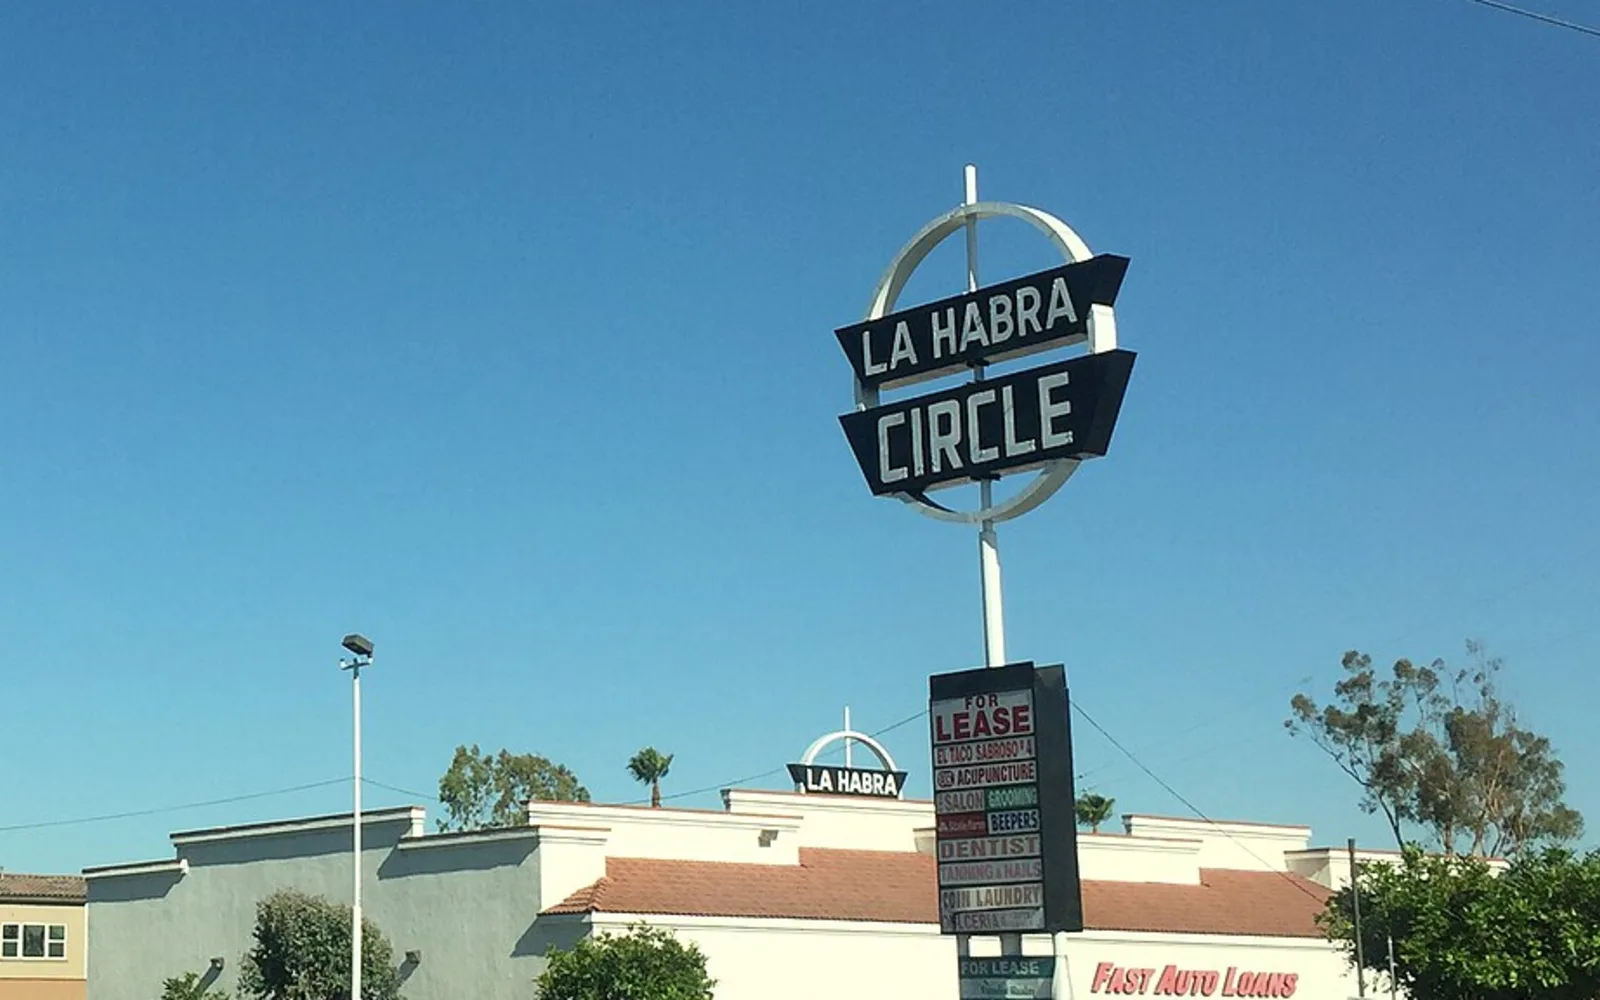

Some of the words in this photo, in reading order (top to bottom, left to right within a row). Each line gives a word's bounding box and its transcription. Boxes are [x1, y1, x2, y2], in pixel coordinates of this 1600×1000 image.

[862, 320, 919, 377] LA
[931, 277, 1078, 359] HABRA
[877, 371, 1074, 484] CIRCLE
[965, 694, 998, 710] FOR
[936, 705, 1031, 741] LEASE
[937, 748, 948, 764] EL
[950, 745, 973, 763] TACO
[806, 768, 833, 792] LA
[838, 770, 897, 796] HABRA
[957, 763, 1035, 786] ACUPUNCTURE
[945, 790, 984, 811] SALON
[988, 786, 1038, 808] GROOMING
[991, 811, 1038, 831] BEEPERS
[941, 836, 1039, 858] DENTIST
[1004, 861, 1042, 878] NAILS
[943, 890, 971, 909] COIN
[976, 885, 1041, 907] LAUNDRY
[961, 961, 988, 975] FOR
[992, 961, 1040, 975] LEASE
[1091, 962, 1155, 995] FAST
[1154, 965, 1220, 997] AUTO
[1222, 966, 1299, 998] LOANS
